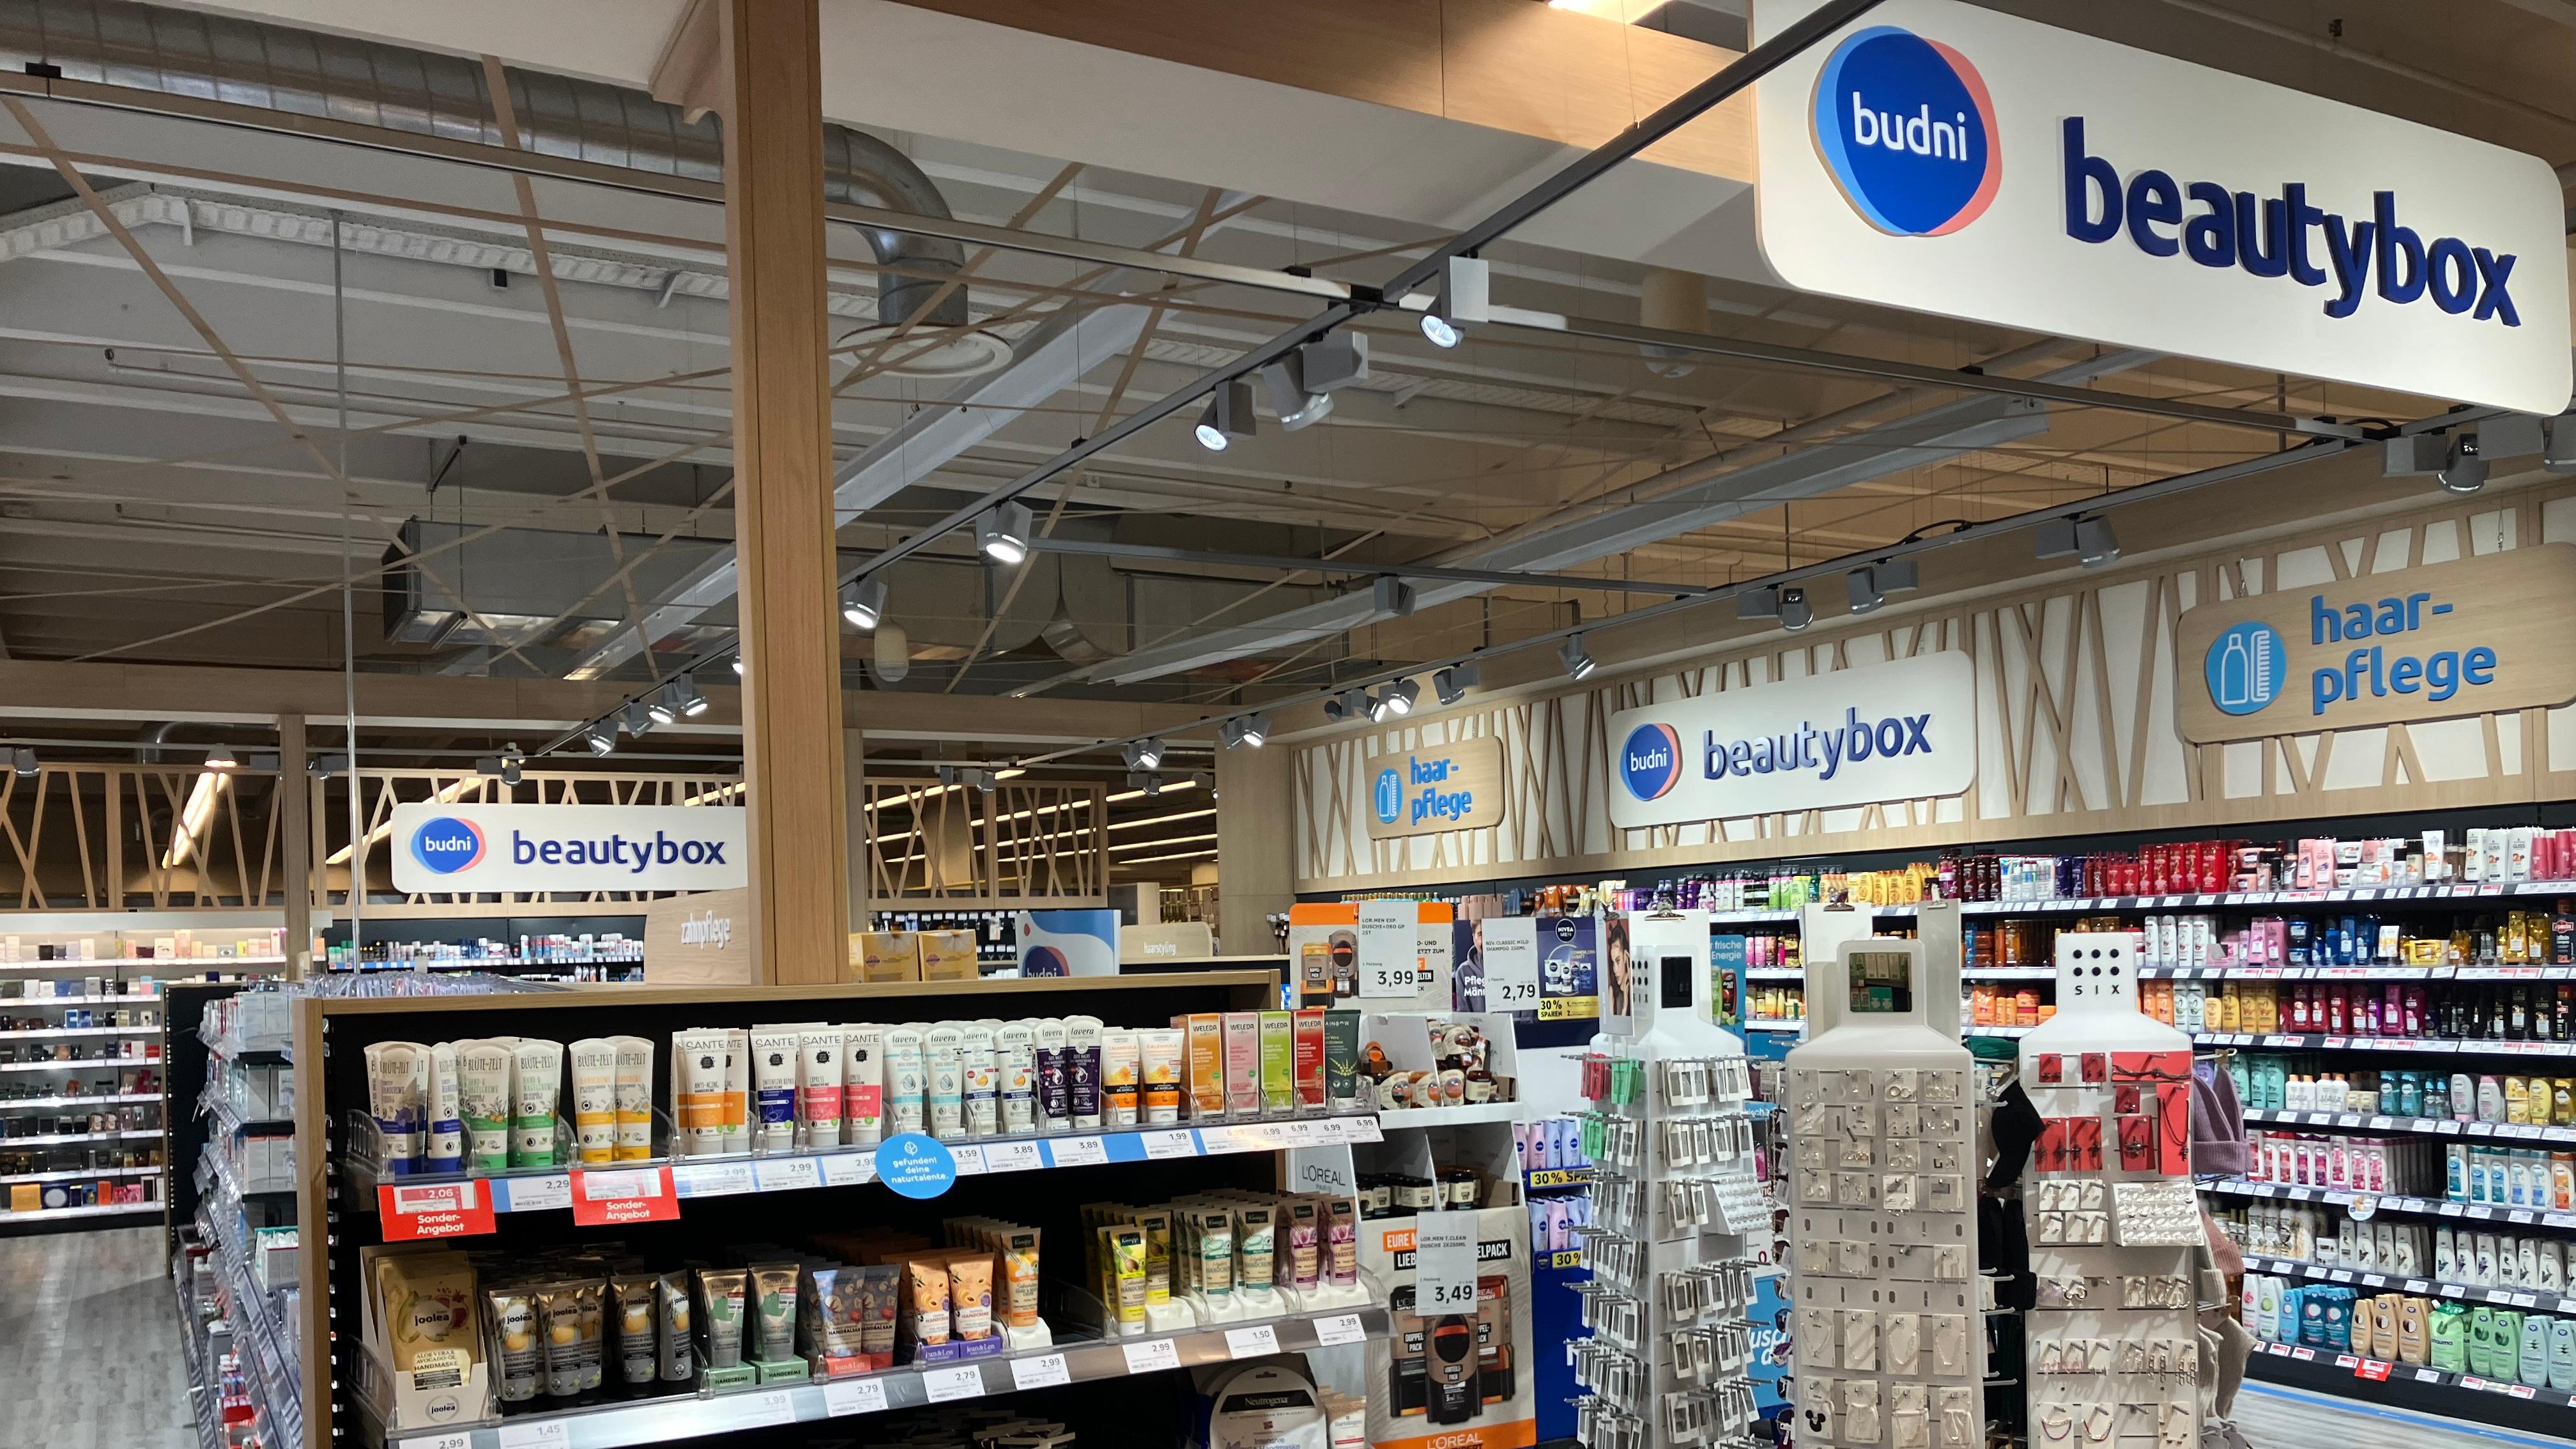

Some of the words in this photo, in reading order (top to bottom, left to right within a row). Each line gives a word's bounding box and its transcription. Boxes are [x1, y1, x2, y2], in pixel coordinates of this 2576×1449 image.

[1853, 91, 1968, 161] budni
[2062, 116, 2522, 328] beautybox
[2311, 592, 2453, 645] haar-
[2312, 645, 2497, 716] pflege
[1703, 707, 1933, 781] beautybox
[1630, 747, 1667, 772] budni
[1410, 756, 1459, 785] haar-
[1411, 787, 1472, 825] pflege
[425, 836, 471, 852] budni
[513, 830, 726, 874] beautybox
[680, 910, 732, 950] zahnpflege
[1143, 941, 1177, 956] haarstyling
[1714, 940, 1742, 949] frische
[1711, 950, 1742, 962] Energie
[1377, 970, 1413, 987] 3,99
[1418, 972, 1431, 981] ELTEN
[1502, 985, 1535, 1001] 2,79
[2074, 985, 2120, 995] SIX
[1540, 1000, 1552, 1010] 30
[1552, 999, 1562, 1009] %
[964, 1032, 988, 1040] lavera
[1003, 1031, 1027, 1039] lavera
[1071, 1027, 1094, 1036] lavera
[755, 1037, 795, 1048] SANTE
[802, 1035, 841, 1045] SANTE
[845, 1034, 880, 1043] SANTE
[892, 1034, 917, 1043] lavera
[930, 1034, 956, 1043] lavera
[686, 1039, 724, 1050] SANTE
[1291, 1123, 1308, 1133] 6,99
[1323, 1123, 1341, 1133] 6,99
[1356, 1118, 1374, 1129] 6,99
[1169, 1132, 1187, 1142] 1,99
[1227, 1128, 1245, 1138] 6,99
[1262, 1127, 1280, 1138] 6,99
[1013, 1145, 1034, 1155] 3,89
[1078, 1140, 1098, 1151] 3,89
[957, 1149, 977, 1160] 3,59
[723, 1167, 746, 1178] 2,99
[789, 1163, 812, 1174] 2,99
[905, 1165, 930, 1174] deine
[1301, 1165, 1346, 1186] L'ORÉAL
[1534, 1173, 1549, 1185] 30
[1551, 1172, 1563, 1183] %
[545, 1179, 570, 1191] 2,29
[427, 1188, 454, 1200] 2,06
[606, 1200, 647, 1211] Sonder-
[417, 1213, 461, 1224] Sonder-
[606, 1209, 650, 1221] Angebot
[417, 1222, 464, 1235] Angebot
[1121, 1236, 1138, 1245] Kneipp
[1386, 1232, 1409, 1248] EURE
[1477, 1242, 1508, 1259] ELPACK
[1397, 1253, 1416, 1268] LIEB
[1556, 1254, 1571, 1265] 30
[1435, 1285, 1473, 1304] 3,49
[625, 1298, 650, 1307] joolea
[553, 1308, 578, 1318] joolea
[415, 1313, 450, 1326] joolea
[507, 1314, 533, 1324] joolea
[1338, 1317, 1357, 1328] 2,99
[1252, 1330, 1270, 1341] 1,50
[966, 1344, 996, 1354] Jean&Len
[1151, 1342, 1170, 1354] 2,99
[1409, 1343, 1423, 1351] PACK
[413, 1360, 459, 1371] HANDMASKE
[834, 1361, 865, 1370] Jean&Len
[1040, 1358, 1061, 1369] 2,99
[769, 1370, 801, 1378] HANDCREME
[954, 1370, 976, 1383] 2,79
[715, 1376, 748, 1384] HANDCREME
[857, 1383, 878, 1395] 2,79
[1245, 1397, 1289, 1406] Neutrogena
[431, 1404, 456, 1414] joolea
[537, 1423, 561, 1436] 1,45
[438, 1438, 464, 1449] 2,99
[1254, 1437, 1285, 1445] Intensive
[1427, 1433, 1483, 1449] L'ORÉAL
